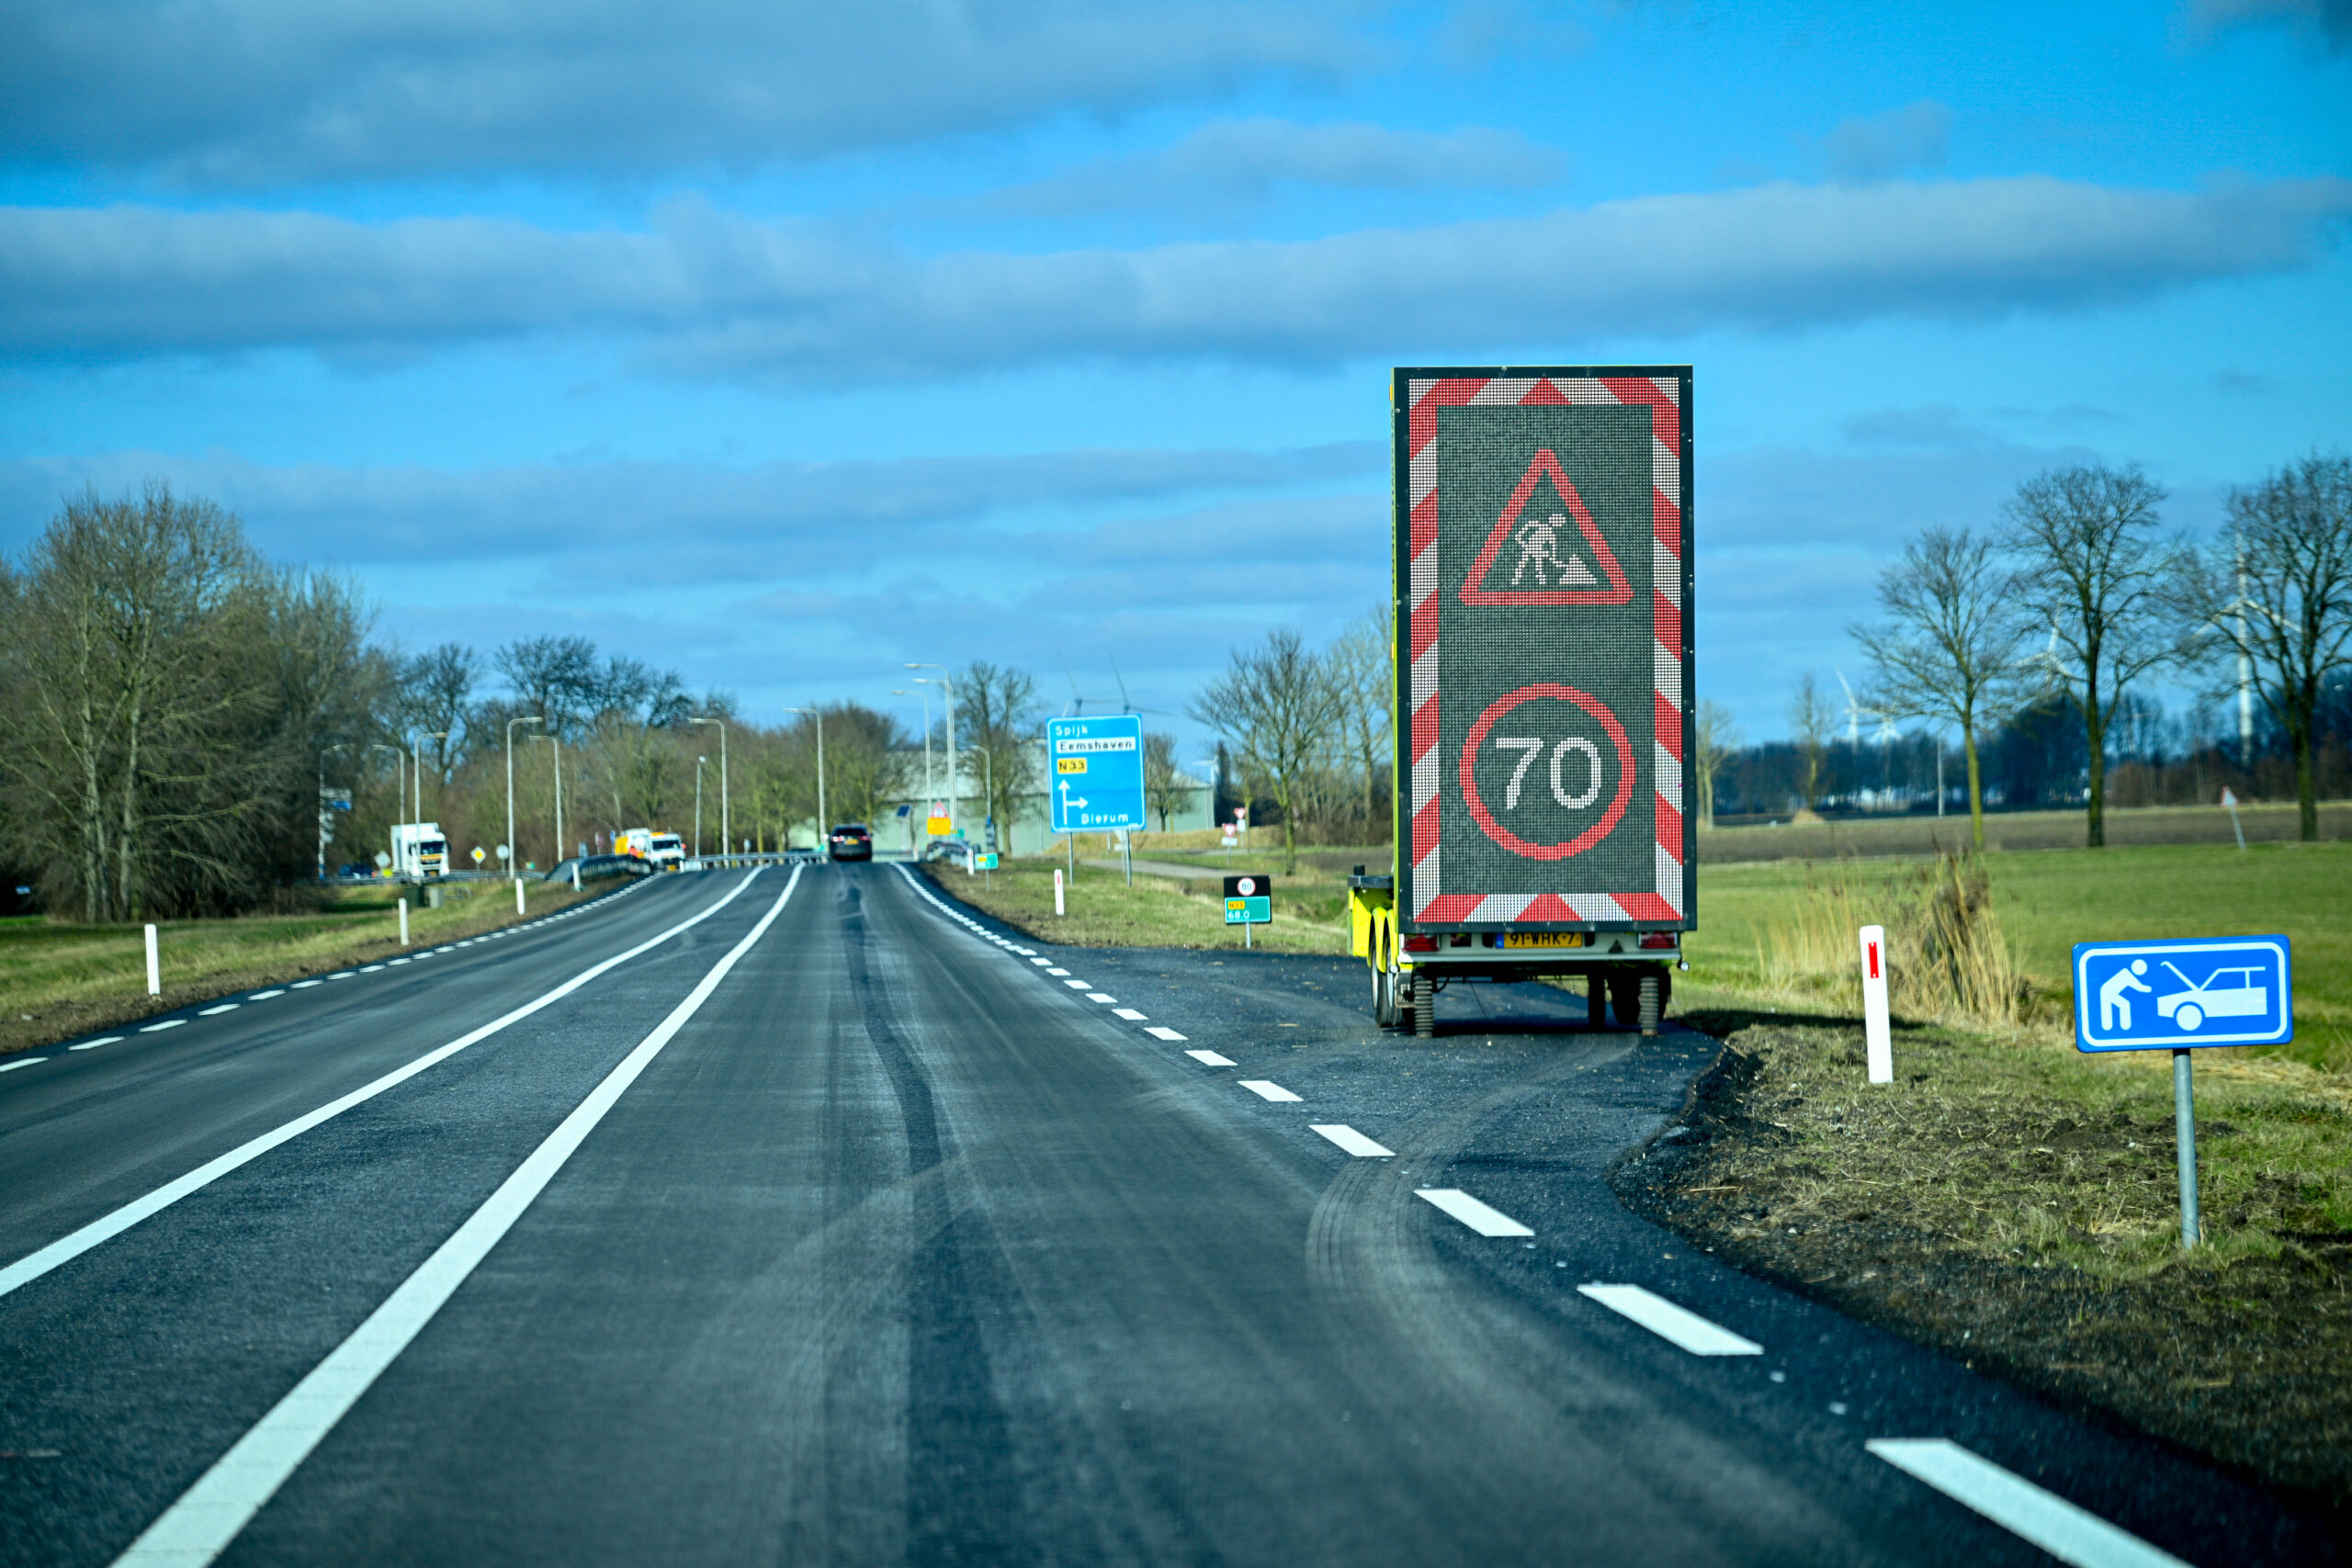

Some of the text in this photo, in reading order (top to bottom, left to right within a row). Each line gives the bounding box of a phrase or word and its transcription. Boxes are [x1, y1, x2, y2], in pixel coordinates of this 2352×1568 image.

[1056, 724, 1088, 738] Spijk
[1060, 739, 1132, 750] Eemshaven
[1059, 760, 1085, 771] N33
[1496, 737, 1600, 809] 70
[1510, 932, 1575, 945] 91-WHK-7
